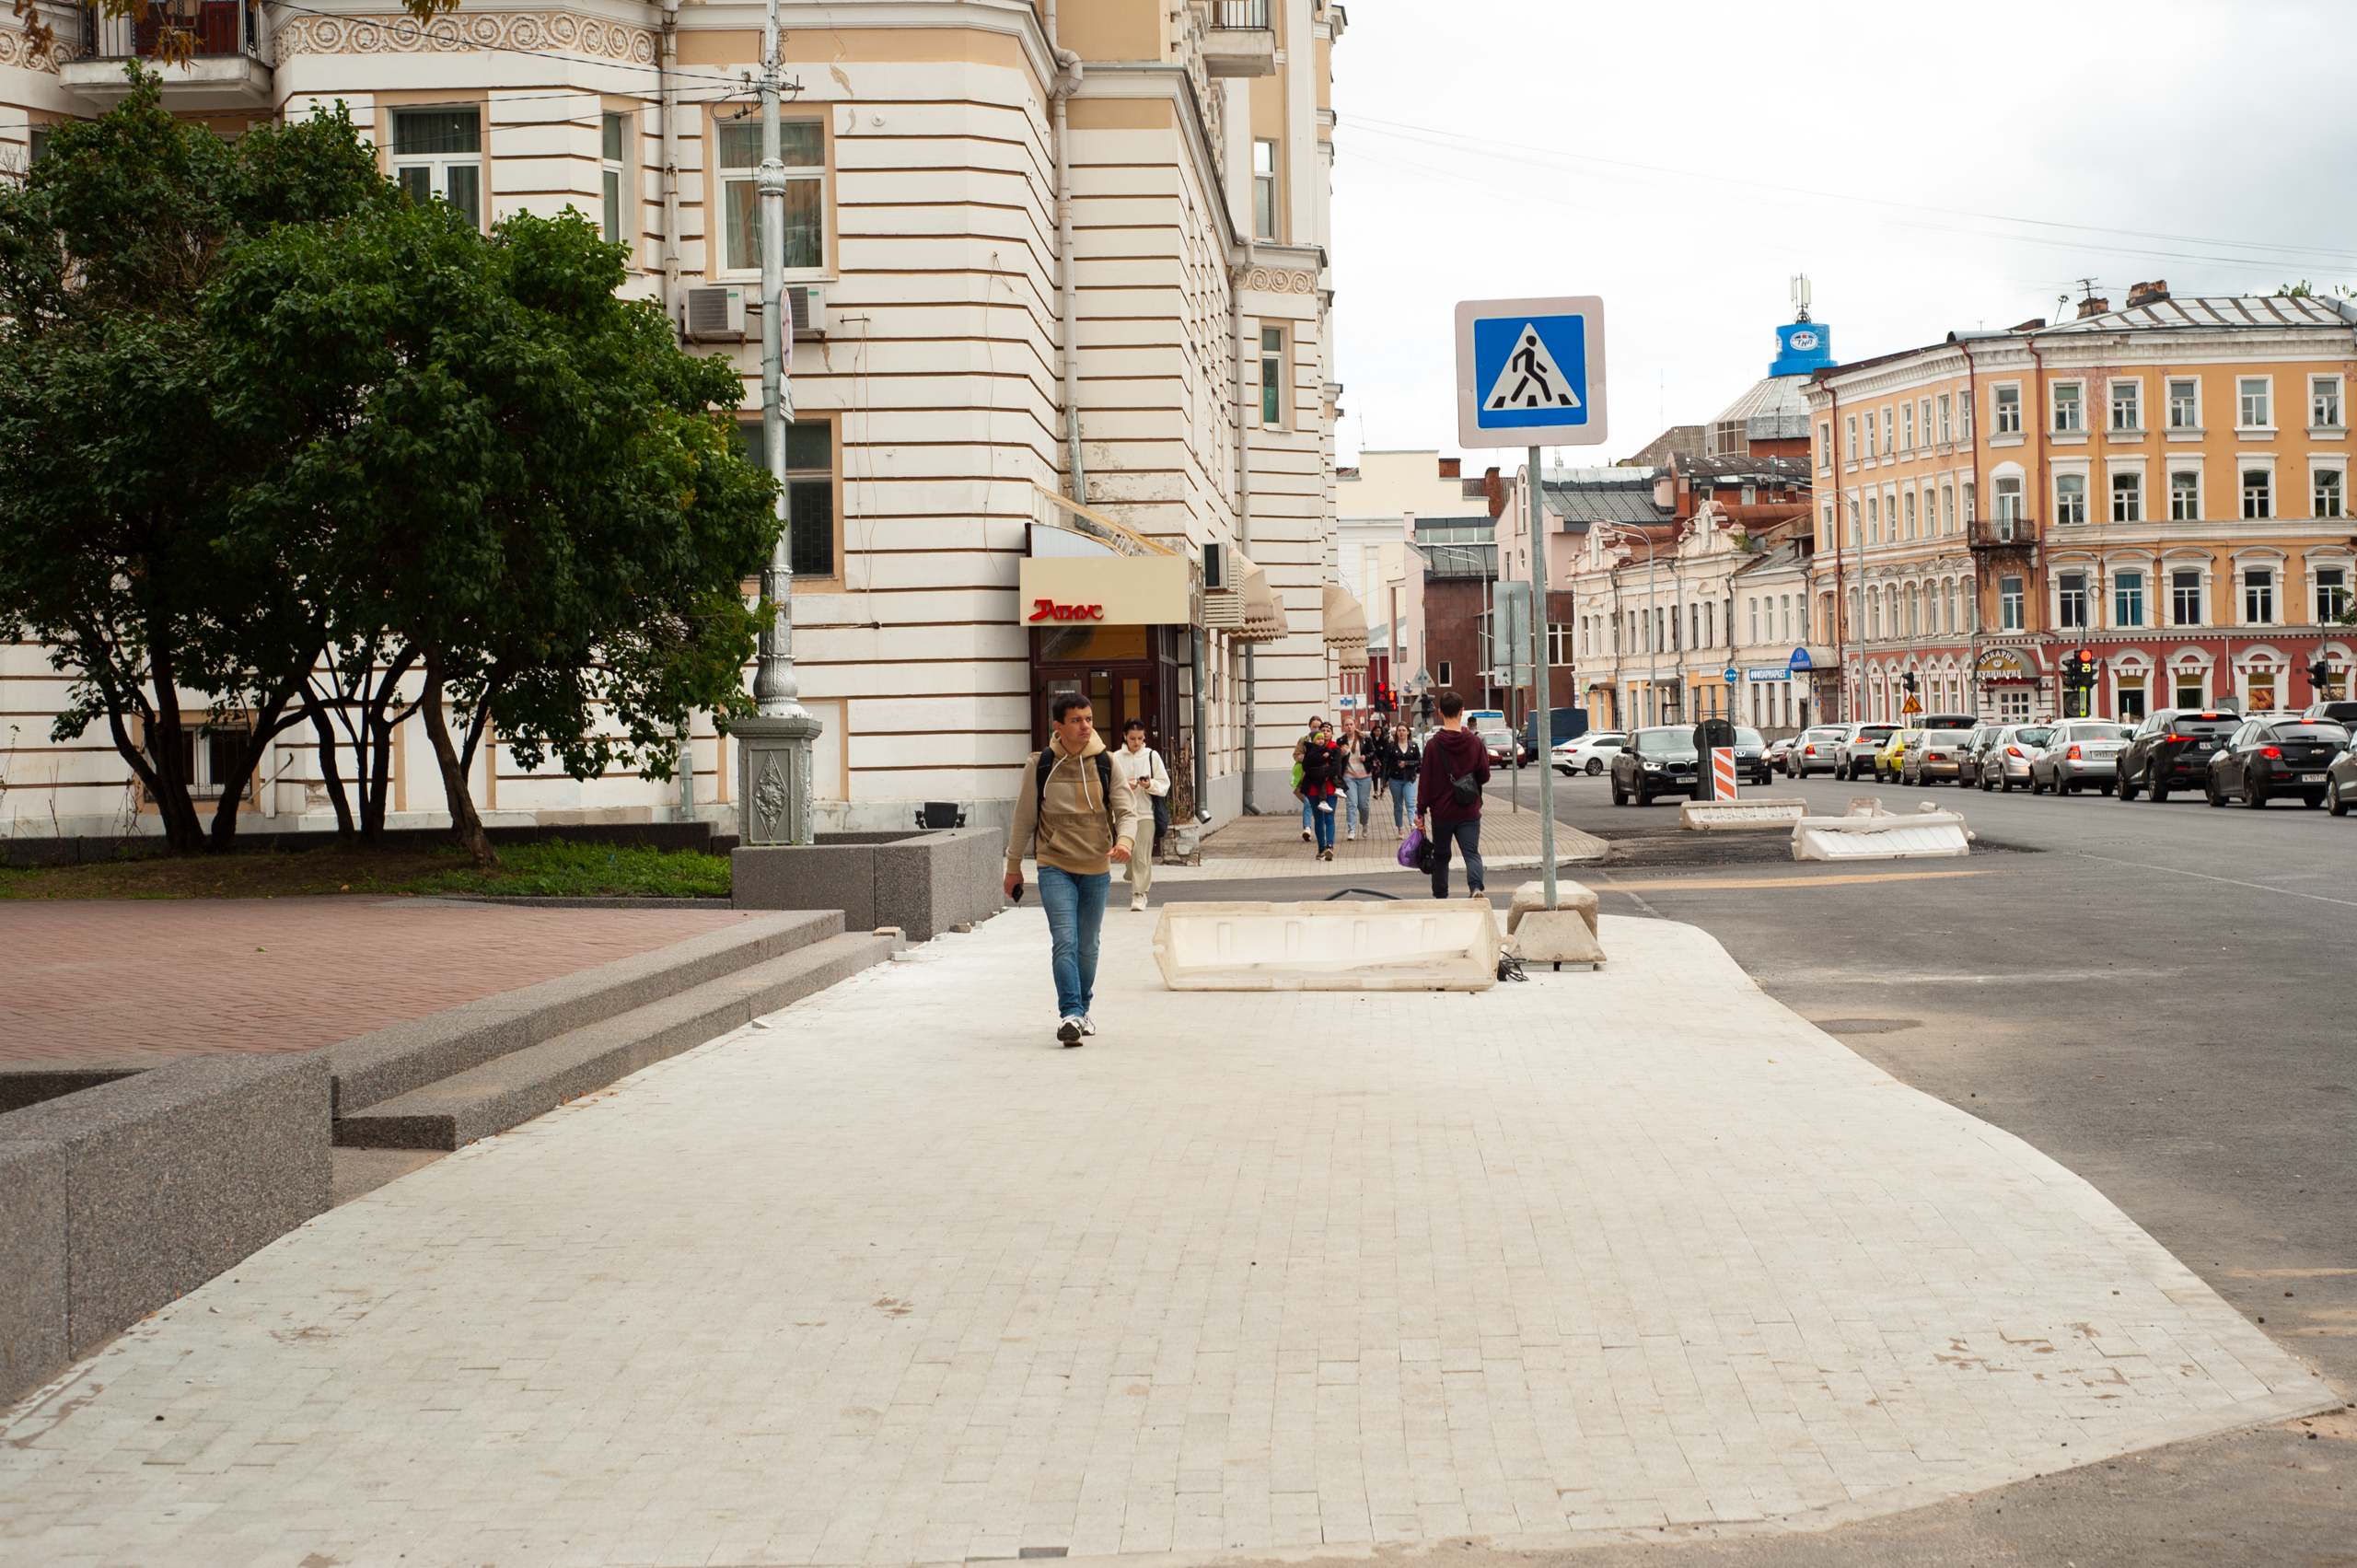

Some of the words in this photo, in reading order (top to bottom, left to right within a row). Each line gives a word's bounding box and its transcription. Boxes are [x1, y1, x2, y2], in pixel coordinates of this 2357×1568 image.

[1979, 650, 2017, 666] ПЕКАРНЯ
[1976, 668, 2022, 678] КУЛИНАРИЯ
[2082, 663, 2091, 673] 29
